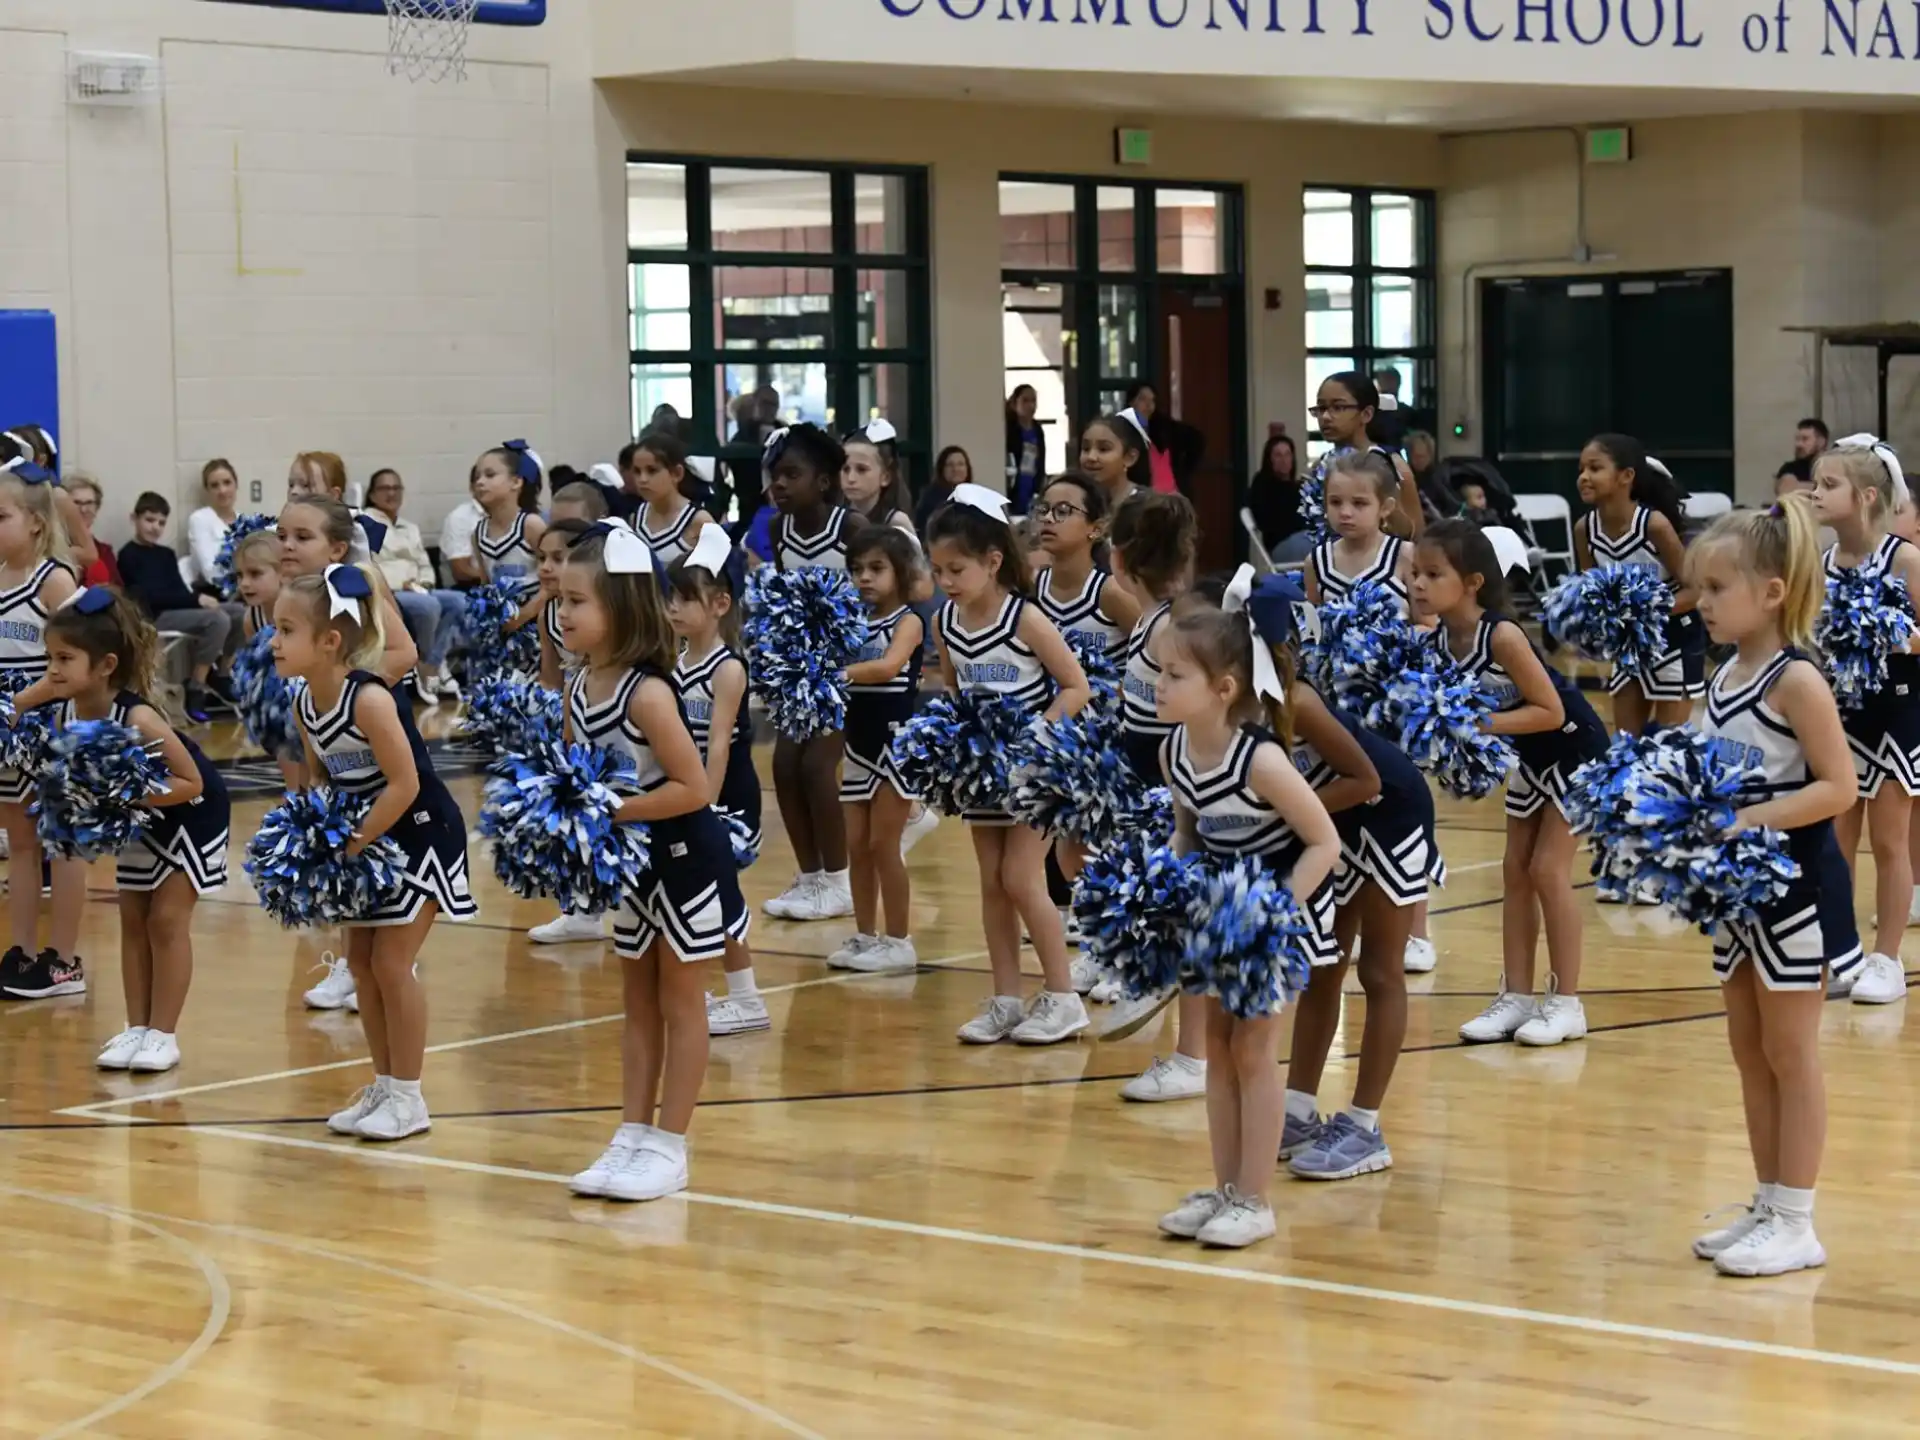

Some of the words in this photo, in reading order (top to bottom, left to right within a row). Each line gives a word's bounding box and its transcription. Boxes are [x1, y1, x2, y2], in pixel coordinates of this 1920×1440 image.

[1426, 0, 1703, 48] SCHOOL
[1742, 0, 1791, 53] of
[1821, 0, 1920, 60] NA
[0, 620, 40, 643] HEER
[964, 663, 1020, 683] CHEER
